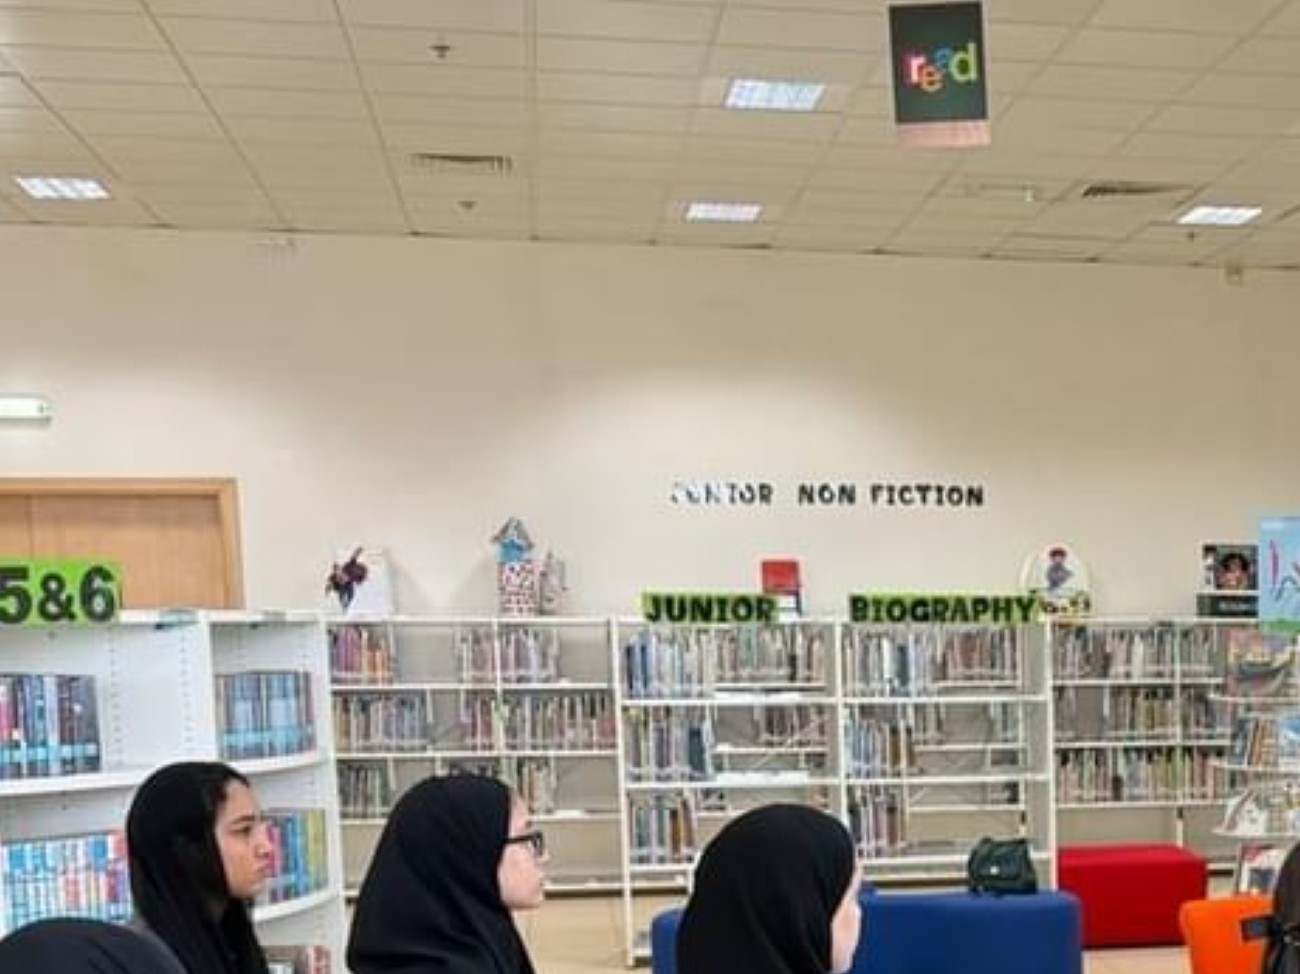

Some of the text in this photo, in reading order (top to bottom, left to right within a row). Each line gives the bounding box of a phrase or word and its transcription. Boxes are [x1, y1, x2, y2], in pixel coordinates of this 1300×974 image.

[907, 41, 977, 92] read
[798, 483, 856, 505] NON
[869, 484, 984, 506] FICTION
[0, 565, 115, 623] 5&6
[645, 594, 1036, 623] JUNIOR BIOGRAPHY
